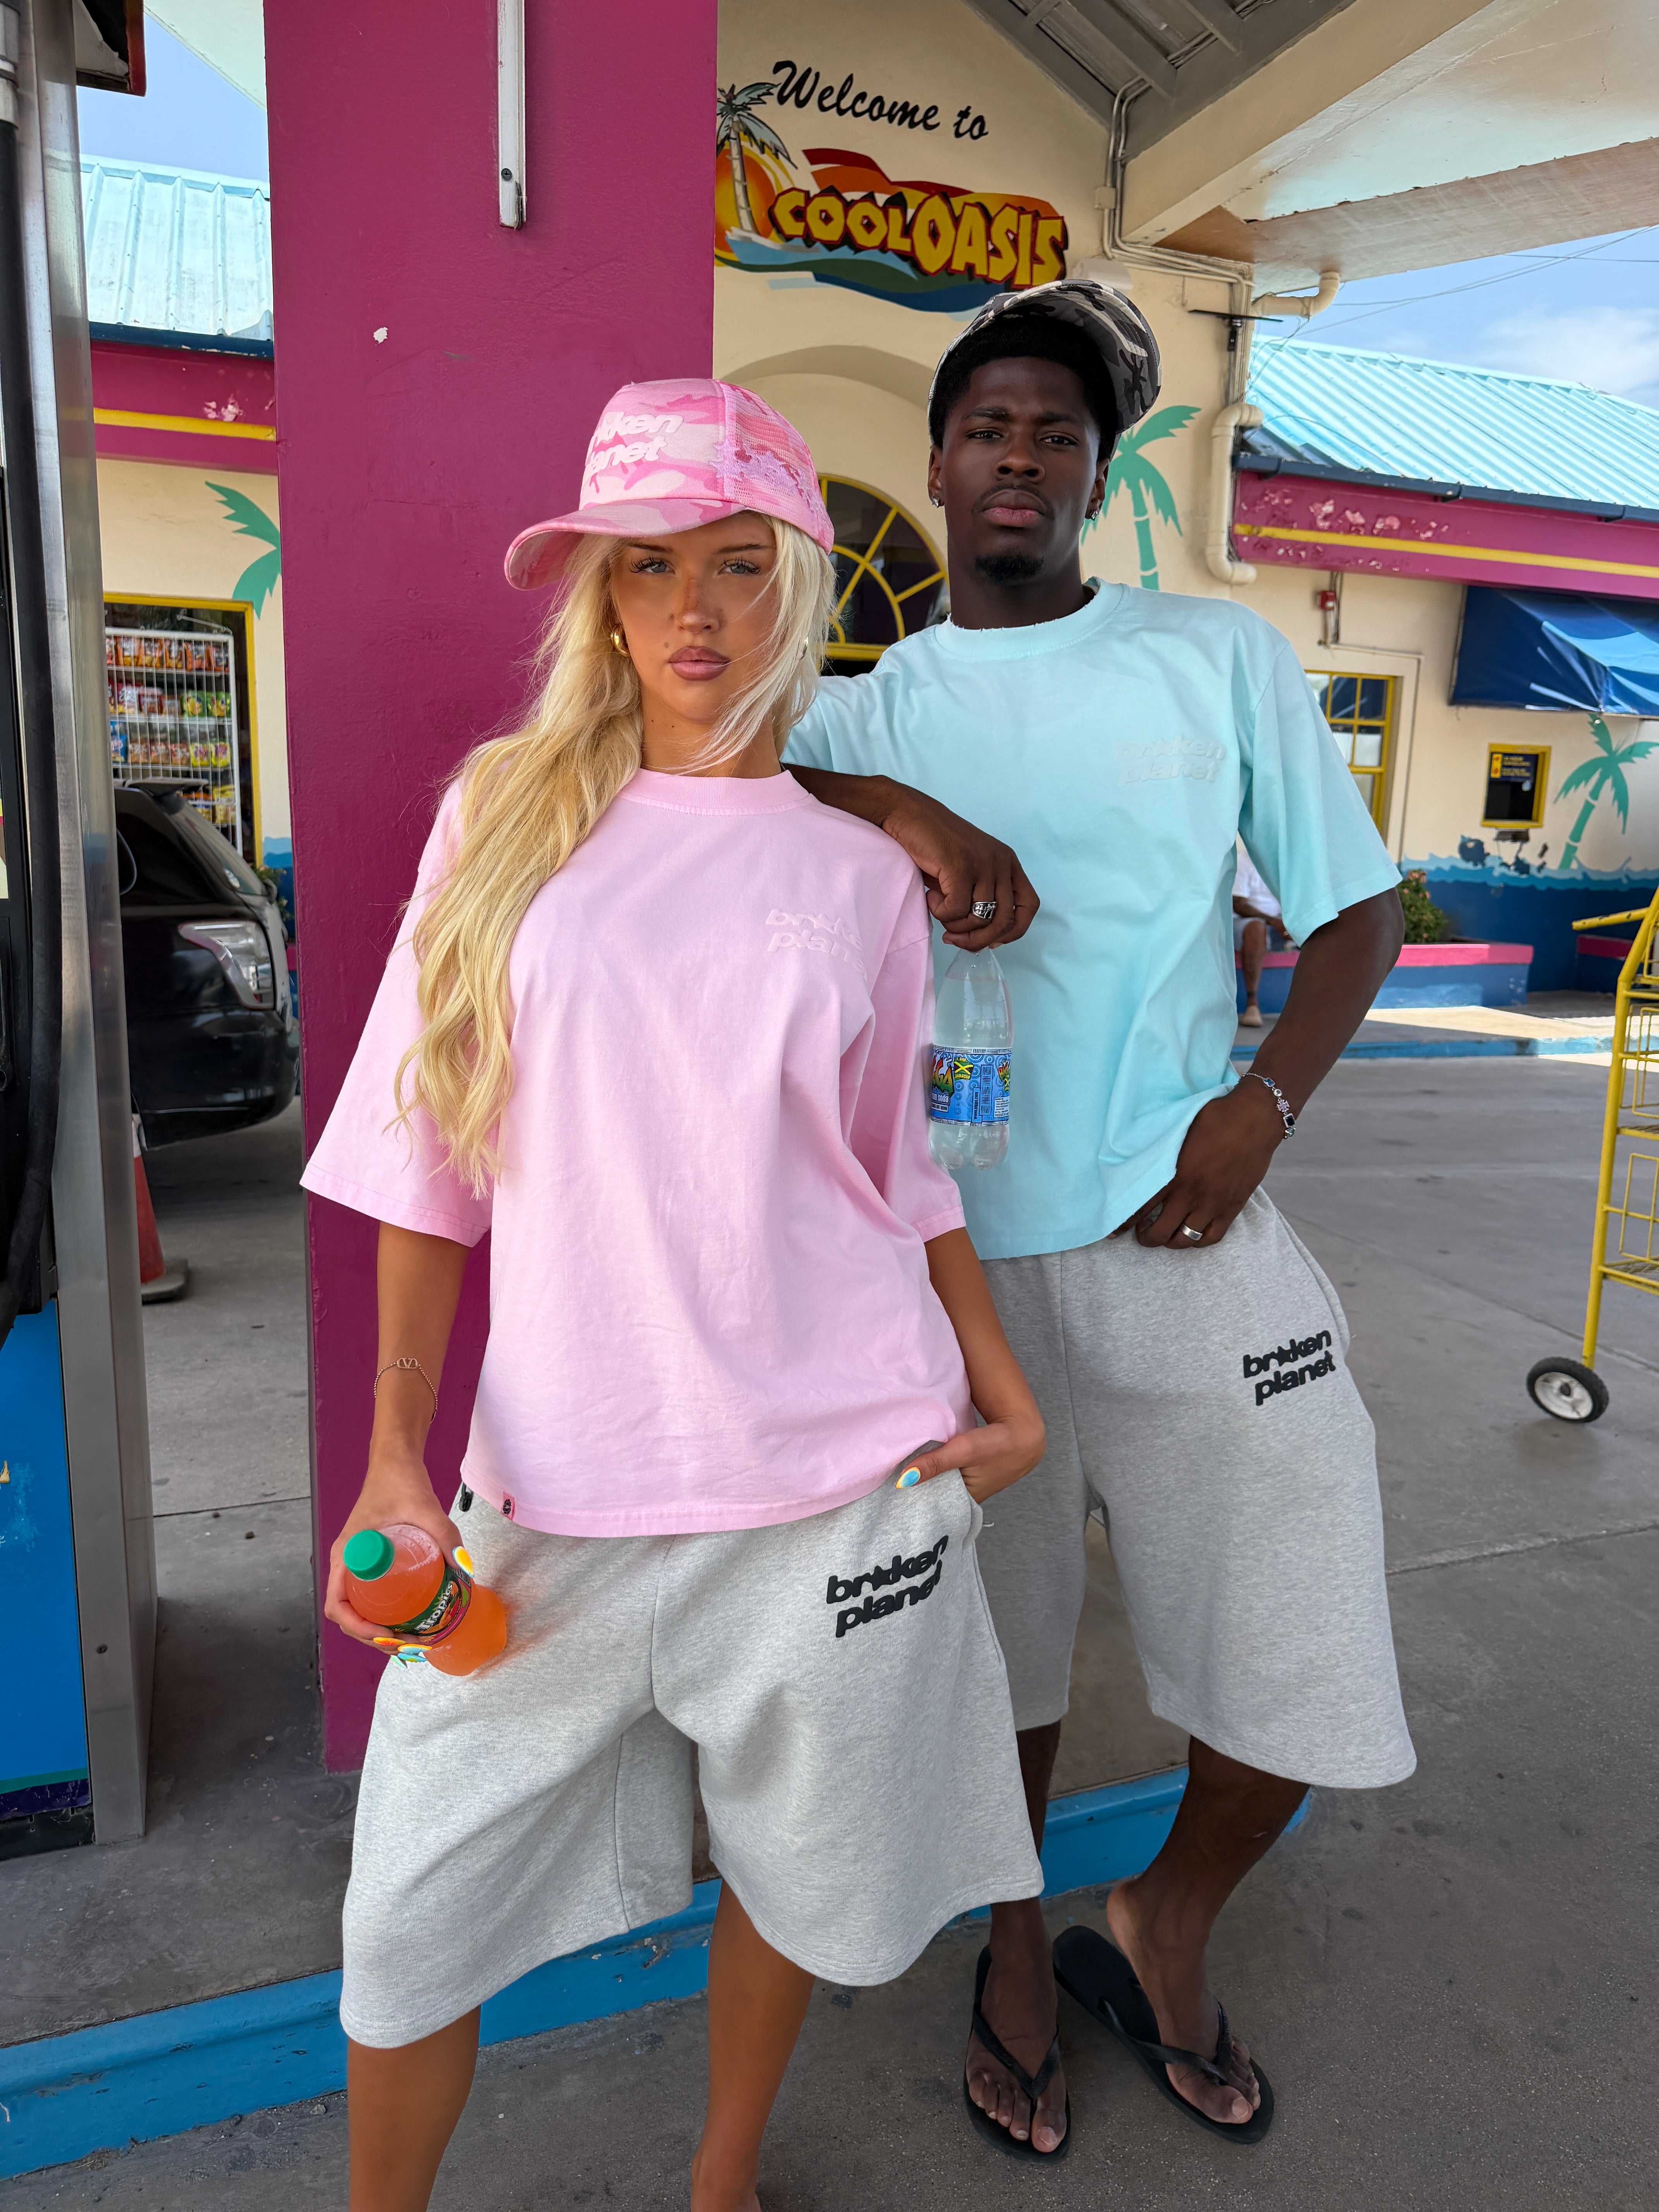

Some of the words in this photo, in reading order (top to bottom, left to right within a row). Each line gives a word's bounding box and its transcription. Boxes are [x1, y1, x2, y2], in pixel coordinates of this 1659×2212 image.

[773, 60, 940, 130] Welcome
[953, 105, 989, 140] to
[1117, 760, 1221, 787] planet
[937, 1093, 949, 1103] soda
[1243, 1330, 1332, 1378] broken
[1255, 1350, 1336, 1406] planet
[414, 1580, 453, 1630] Tropics
